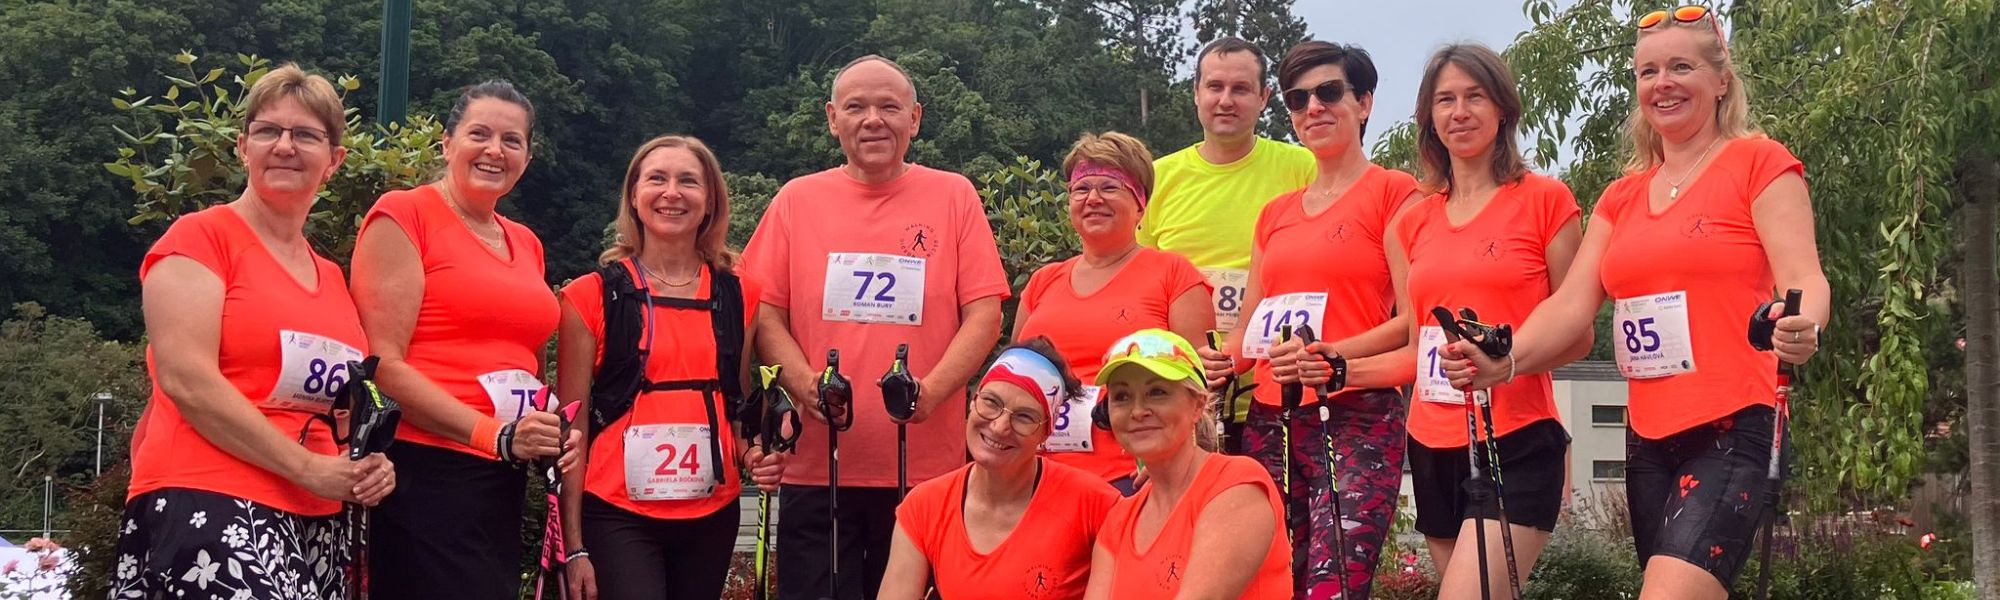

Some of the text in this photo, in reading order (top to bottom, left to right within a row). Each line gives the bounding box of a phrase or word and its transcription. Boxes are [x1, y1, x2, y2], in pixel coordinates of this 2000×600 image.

[853, 271, 896, 302] 72
[1262, 310, 1310, 338] 142
[1622, 317, 1661, 354] 85
[303, 358, 346, 398] 86
[655, 444, 700, 475] 24
